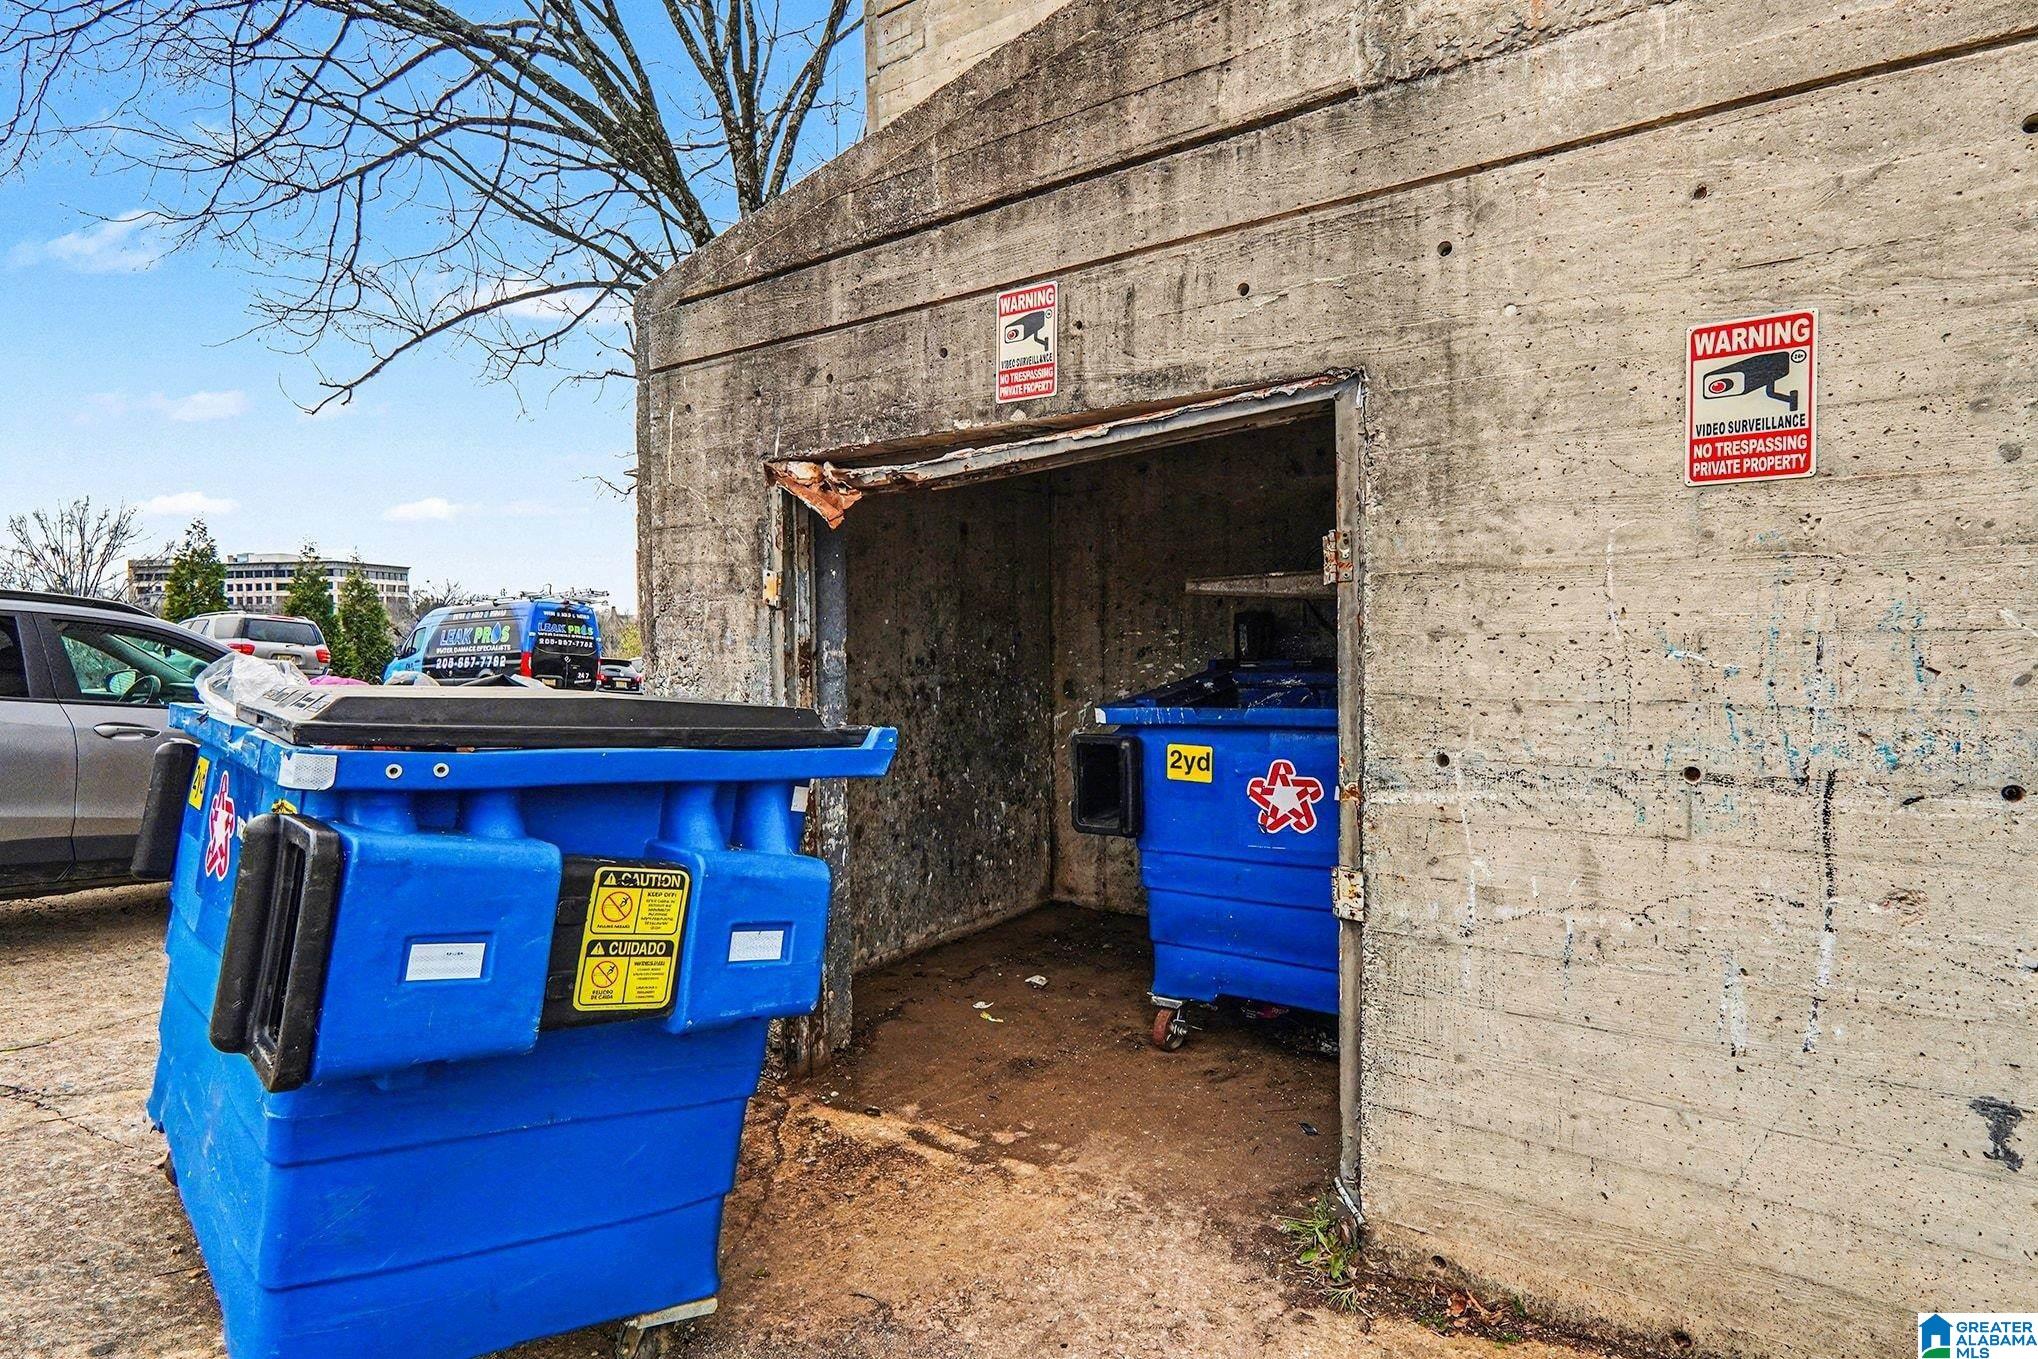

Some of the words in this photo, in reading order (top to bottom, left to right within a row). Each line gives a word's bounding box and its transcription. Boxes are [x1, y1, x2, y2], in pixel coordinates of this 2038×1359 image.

[1000, 288, 1055, 315] WARNING
[1694, 318, 1811, 356] WARNING
[1001, 359, 1015, 369] VIDEO
[1016, 353, 1053, 367] SURVEILLANCE
[1000, 374, 1009, 384] NO
[1010, 367, 1054, 384] TRESPASSING
[1000, 384, 1024, 398] PRIVATE
[1024, 380, 1053, 395] PROPERTY
[1696, 423, 1725, 437] VIDEO
[1728, 413, 1806, 434] SURVEILLANCE
[1693, 443, 1713, 459] NO
[1715, 434, 1807, 458] TRESPASSING
[1693, 459, 1741, 477] PRIVATE
[1743, 453, 1807, 473] PROPERTY
[440, 627, 473, 646] LEAK
[473, 622, 511, 645] PROS
[537, 622, 567, 634] LEAK
[567, 624, 594, 636] PROS
[1169, 749, 1211, 775] 2yd
[621, 872, 681, 888] CAUTION
[608, 941, 666, 956] CUIDADO
